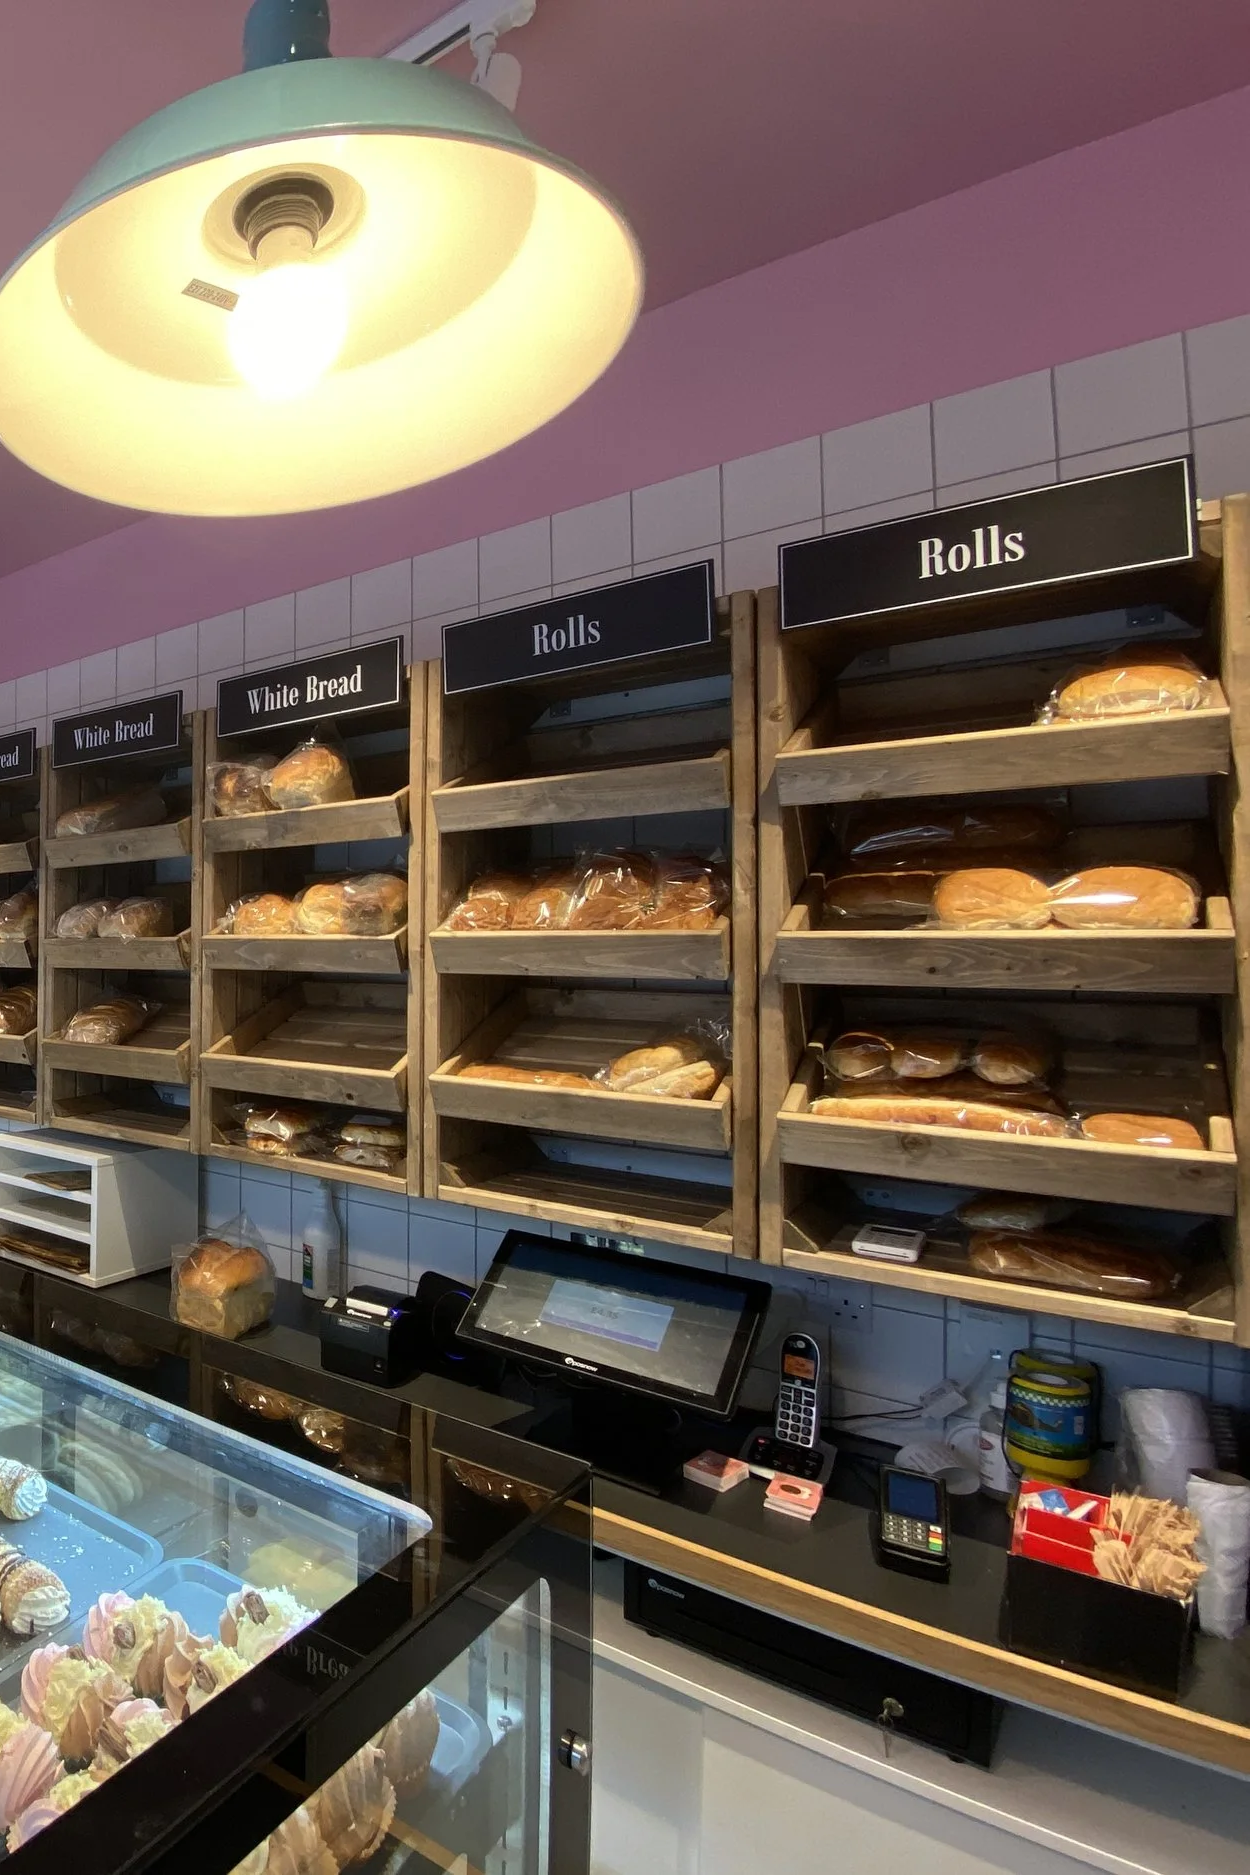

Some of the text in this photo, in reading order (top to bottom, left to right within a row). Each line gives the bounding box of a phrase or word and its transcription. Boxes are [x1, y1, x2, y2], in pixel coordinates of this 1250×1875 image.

[917, 524, 1025, 579] Rolls
[531, 614, 601, 657] Rolls
[246, 664, 363, 715] White Bread
[73, 712, 154, 750] White Bread
